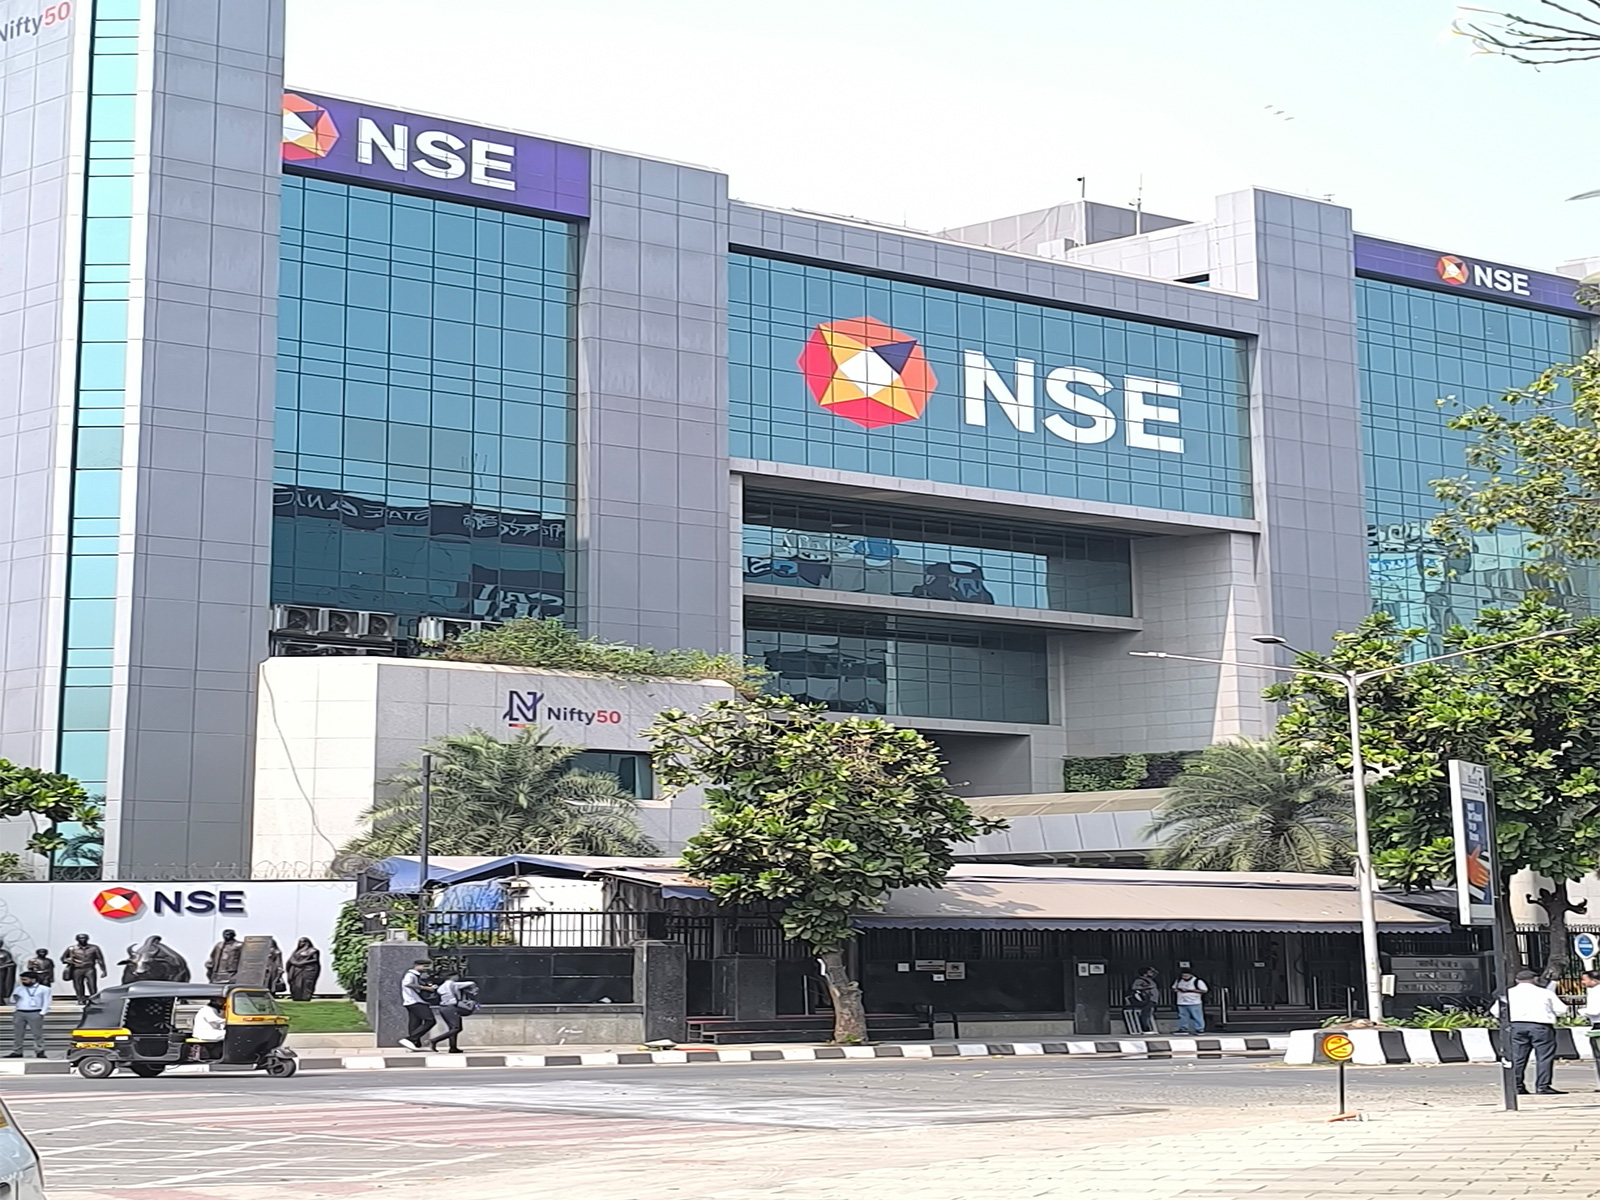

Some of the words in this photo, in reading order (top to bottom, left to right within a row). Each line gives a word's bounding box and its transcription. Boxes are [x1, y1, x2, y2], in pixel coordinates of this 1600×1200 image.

[357, 117, 516, 191] NSE
[1474, 264, 1531, 296] NSE
[964, 349, 1184, 454] NSE
[547, 707, 622, 726] Nifty50
[154, 890, 245, 914] NSE
